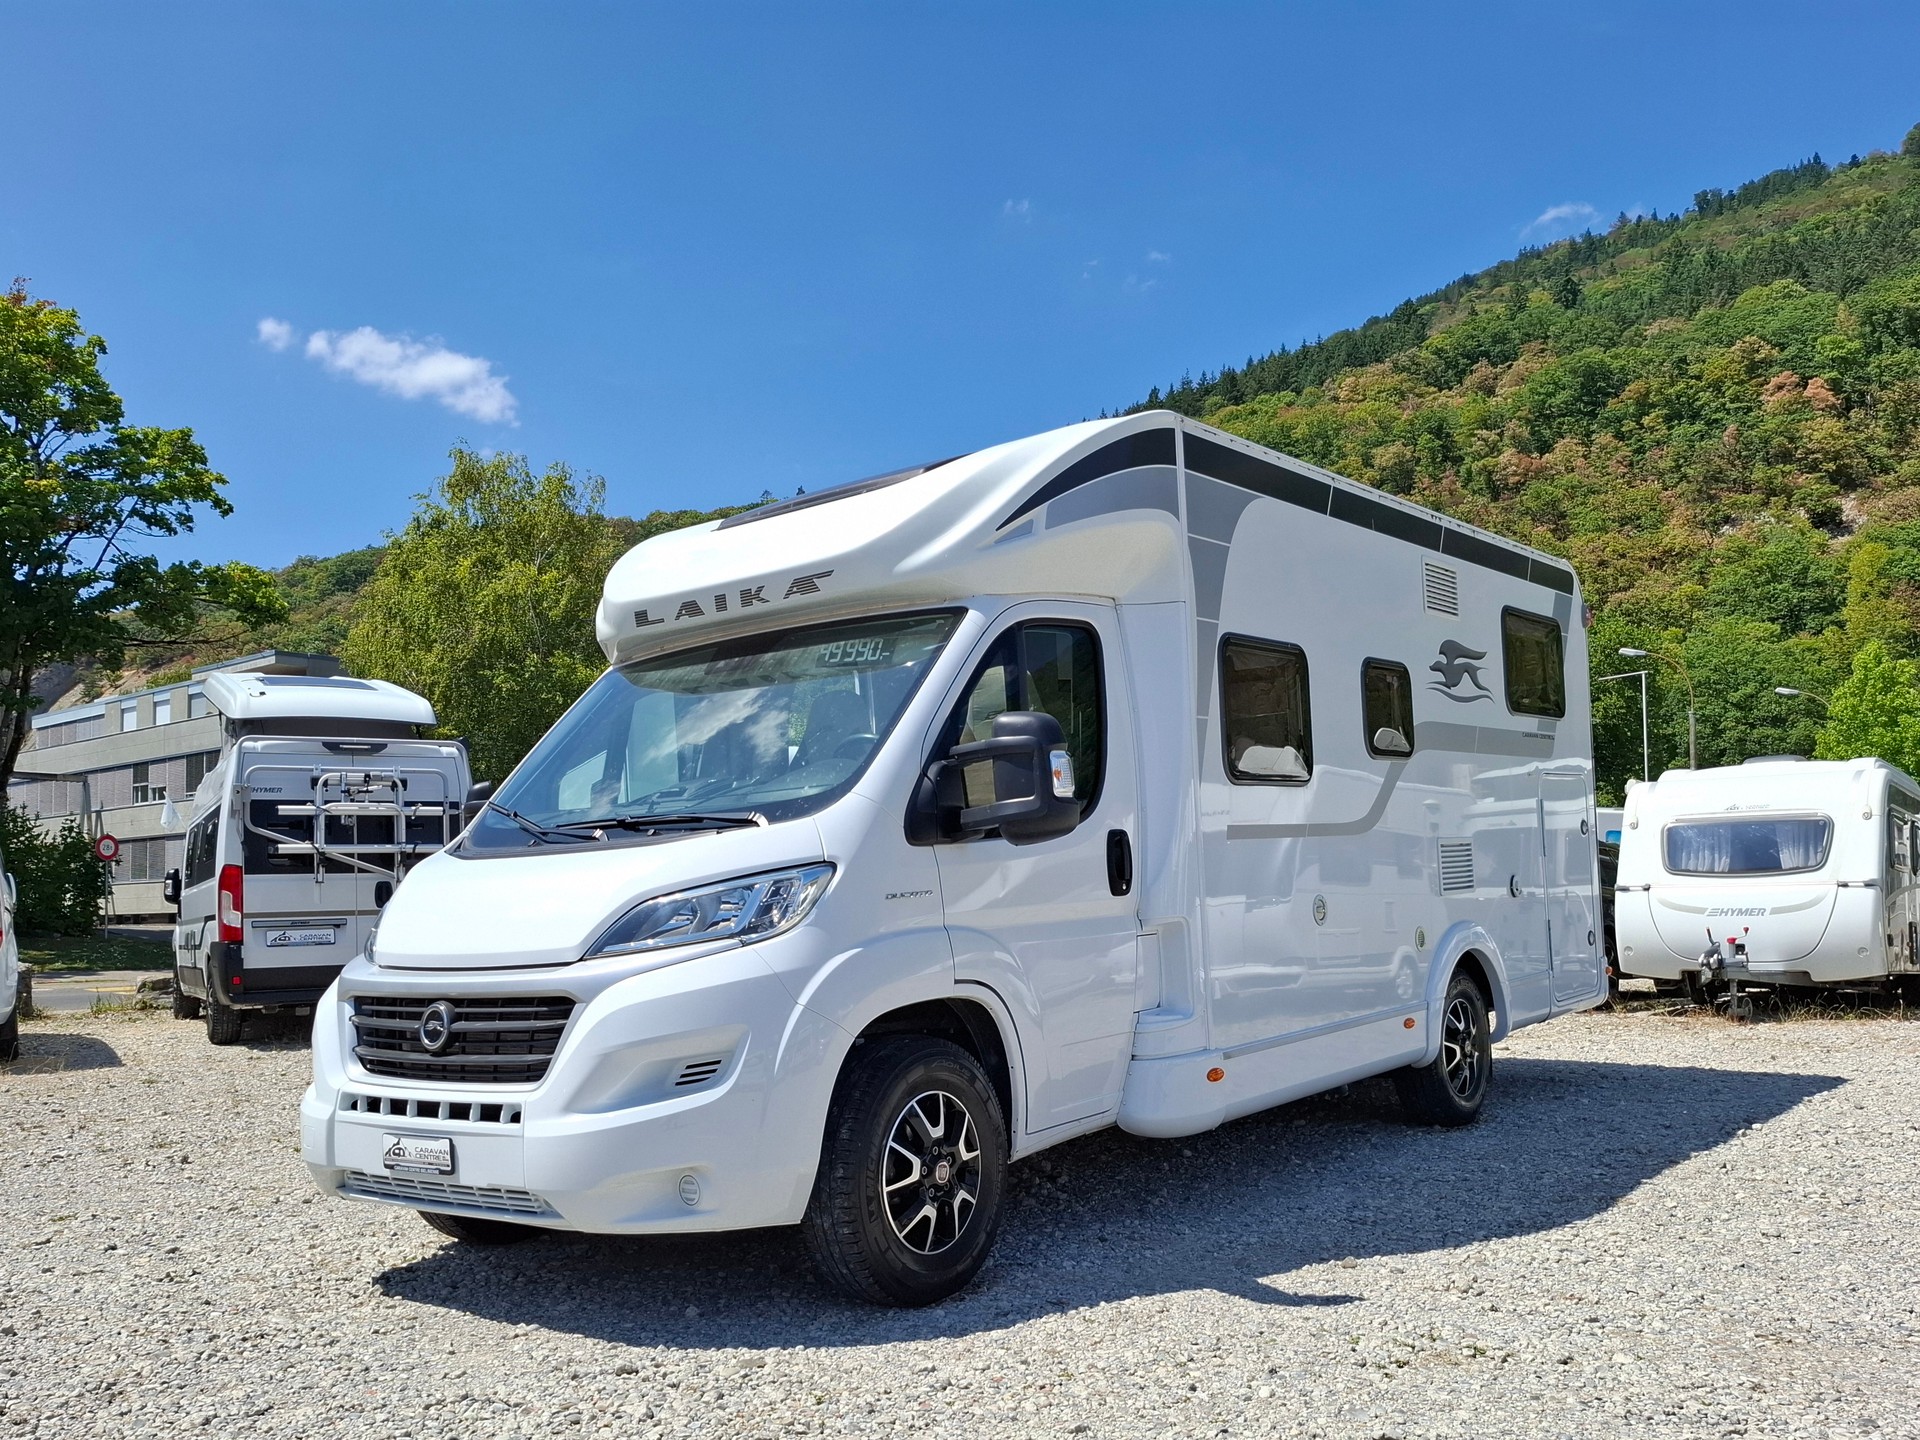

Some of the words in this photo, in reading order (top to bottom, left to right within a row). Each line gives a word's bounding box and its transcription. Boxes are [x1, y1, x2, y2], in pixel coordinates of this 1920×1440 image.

[633, 569, 835, 628] LAIKA
[885, 889, 934, 900] DUCATO
[1719, 907, 1767, 917] HYMER
[415, 1147, 448, 1155] CARAVAN
[414, 1153, 441, 1161] CENTRE
